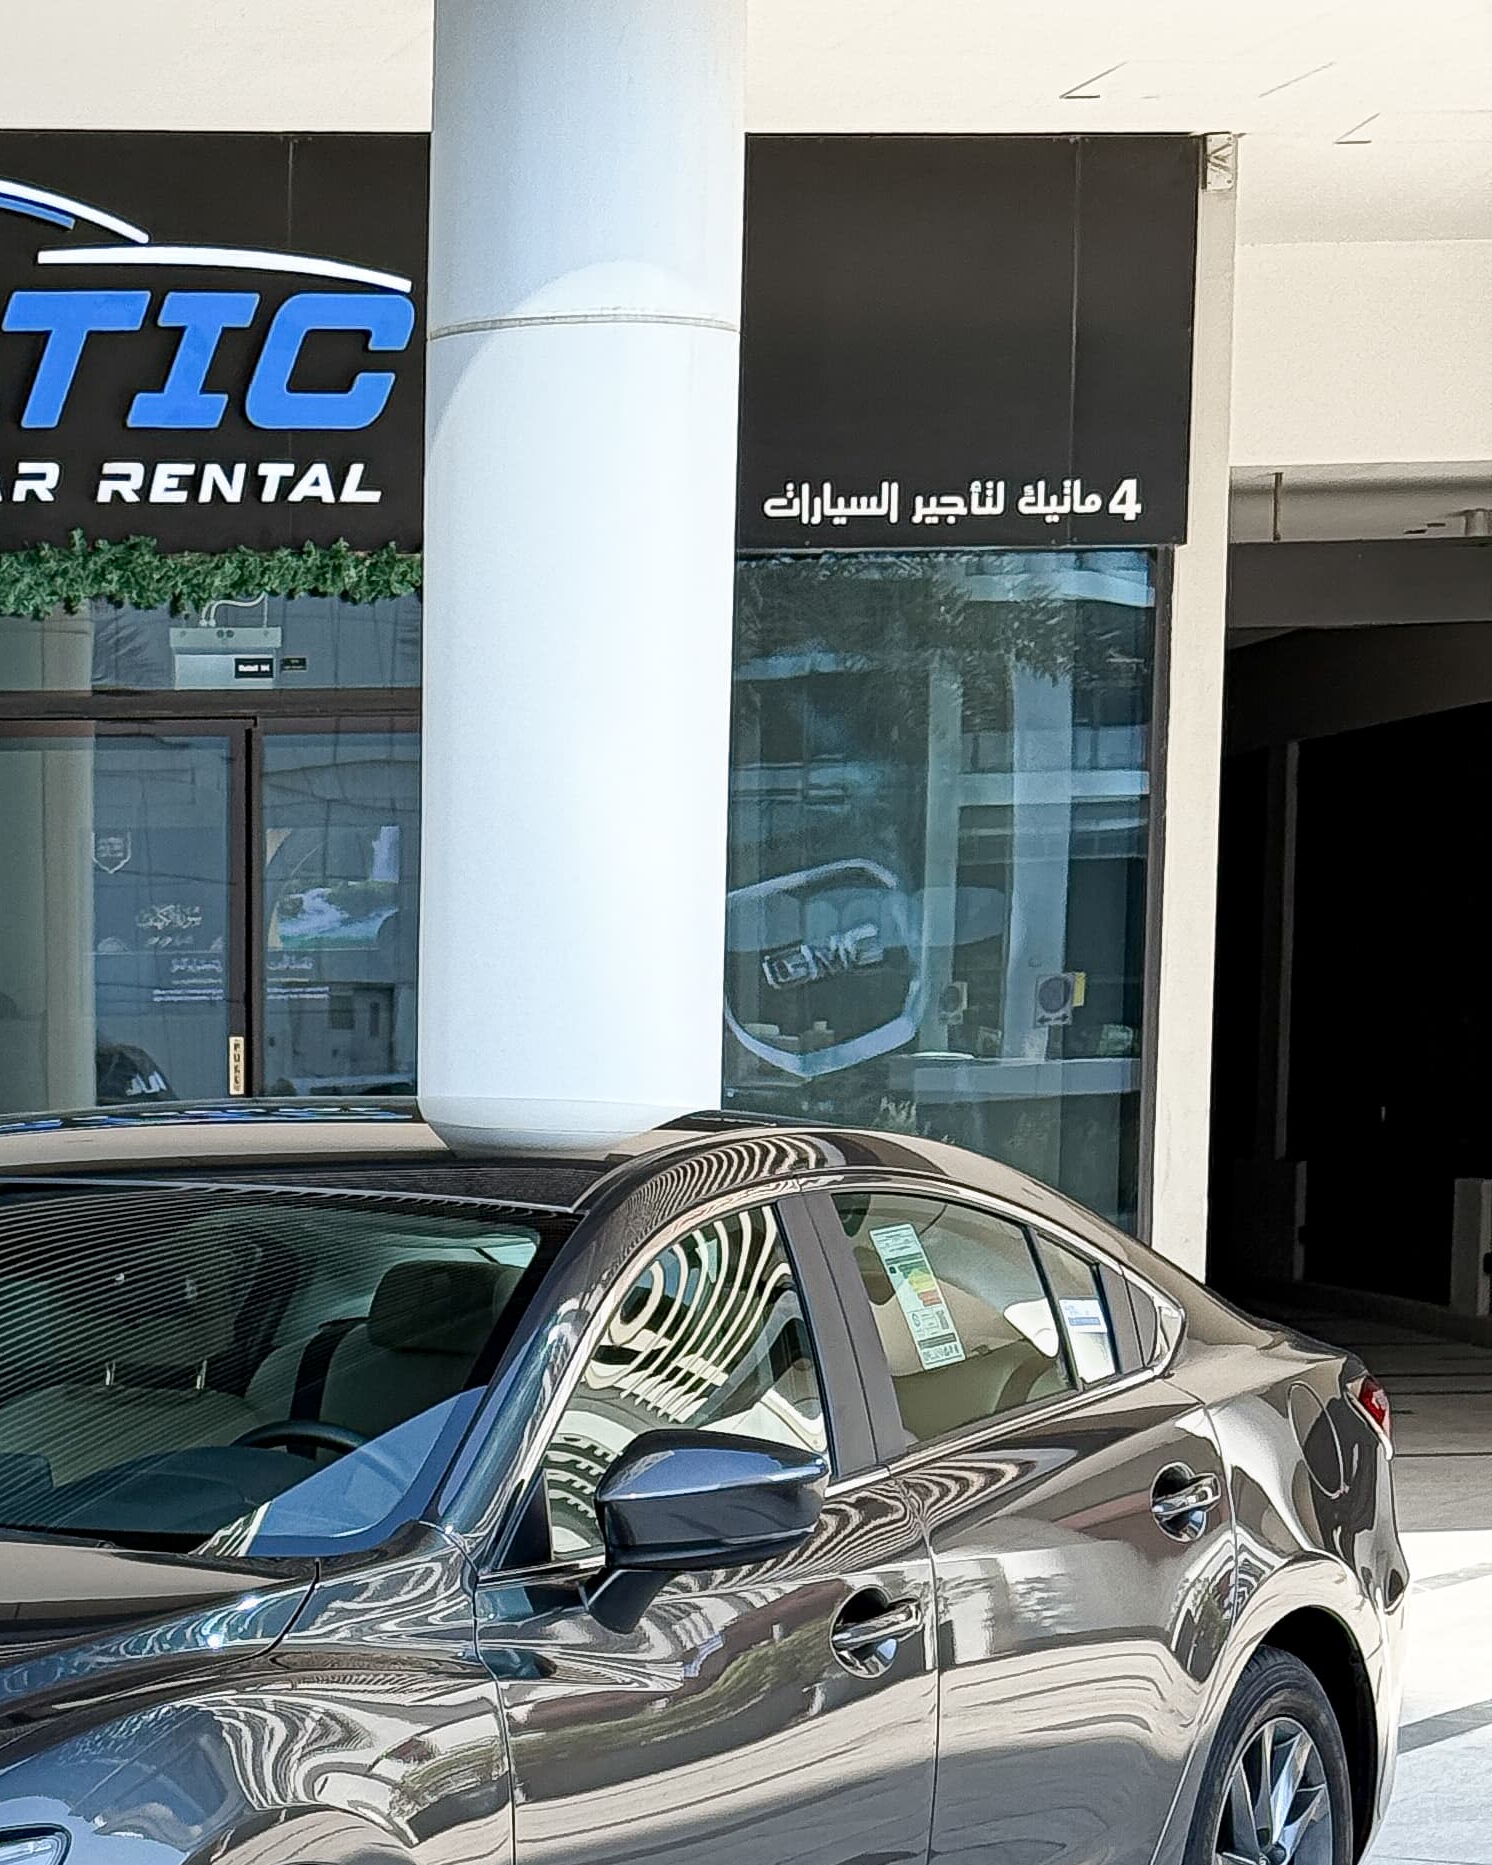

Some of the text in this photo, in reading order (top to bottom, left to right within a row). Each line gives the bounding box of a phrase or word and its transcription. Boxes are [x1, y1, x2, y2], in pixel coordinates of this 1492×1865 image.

[95, 460, 383, 504] RENTAL
[762, 478, 1143, 525] 4 ماتيك لتأجير السيارات
